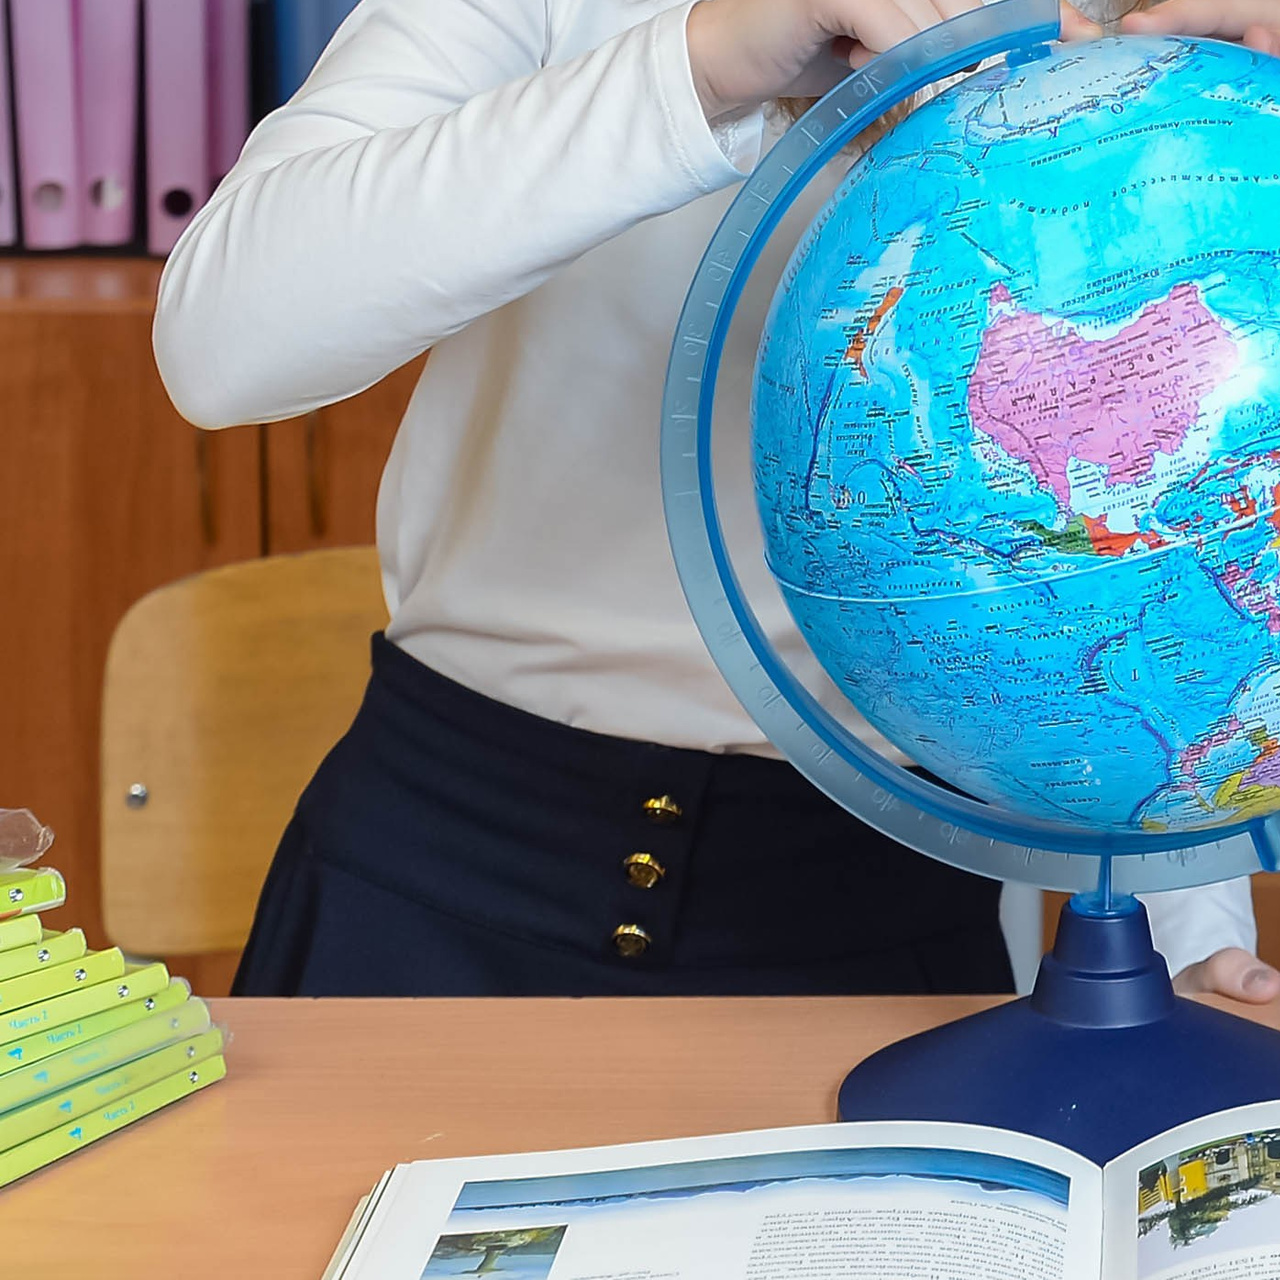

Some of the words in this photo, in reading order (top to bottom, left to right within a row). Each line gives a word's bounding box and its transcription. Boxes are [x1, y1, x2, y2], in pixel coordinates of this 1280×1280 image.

[1097, 118, 1233, 145] Австрало-Антарктическая
[1030, 145, 1082, 168] котловина
[1009, 198, 1090, 216] поднятие
[1061, 268, 1160, 309] Южно-Австралийская
[1011, 344, 1174, 407] АВСТРАЛИЯ
